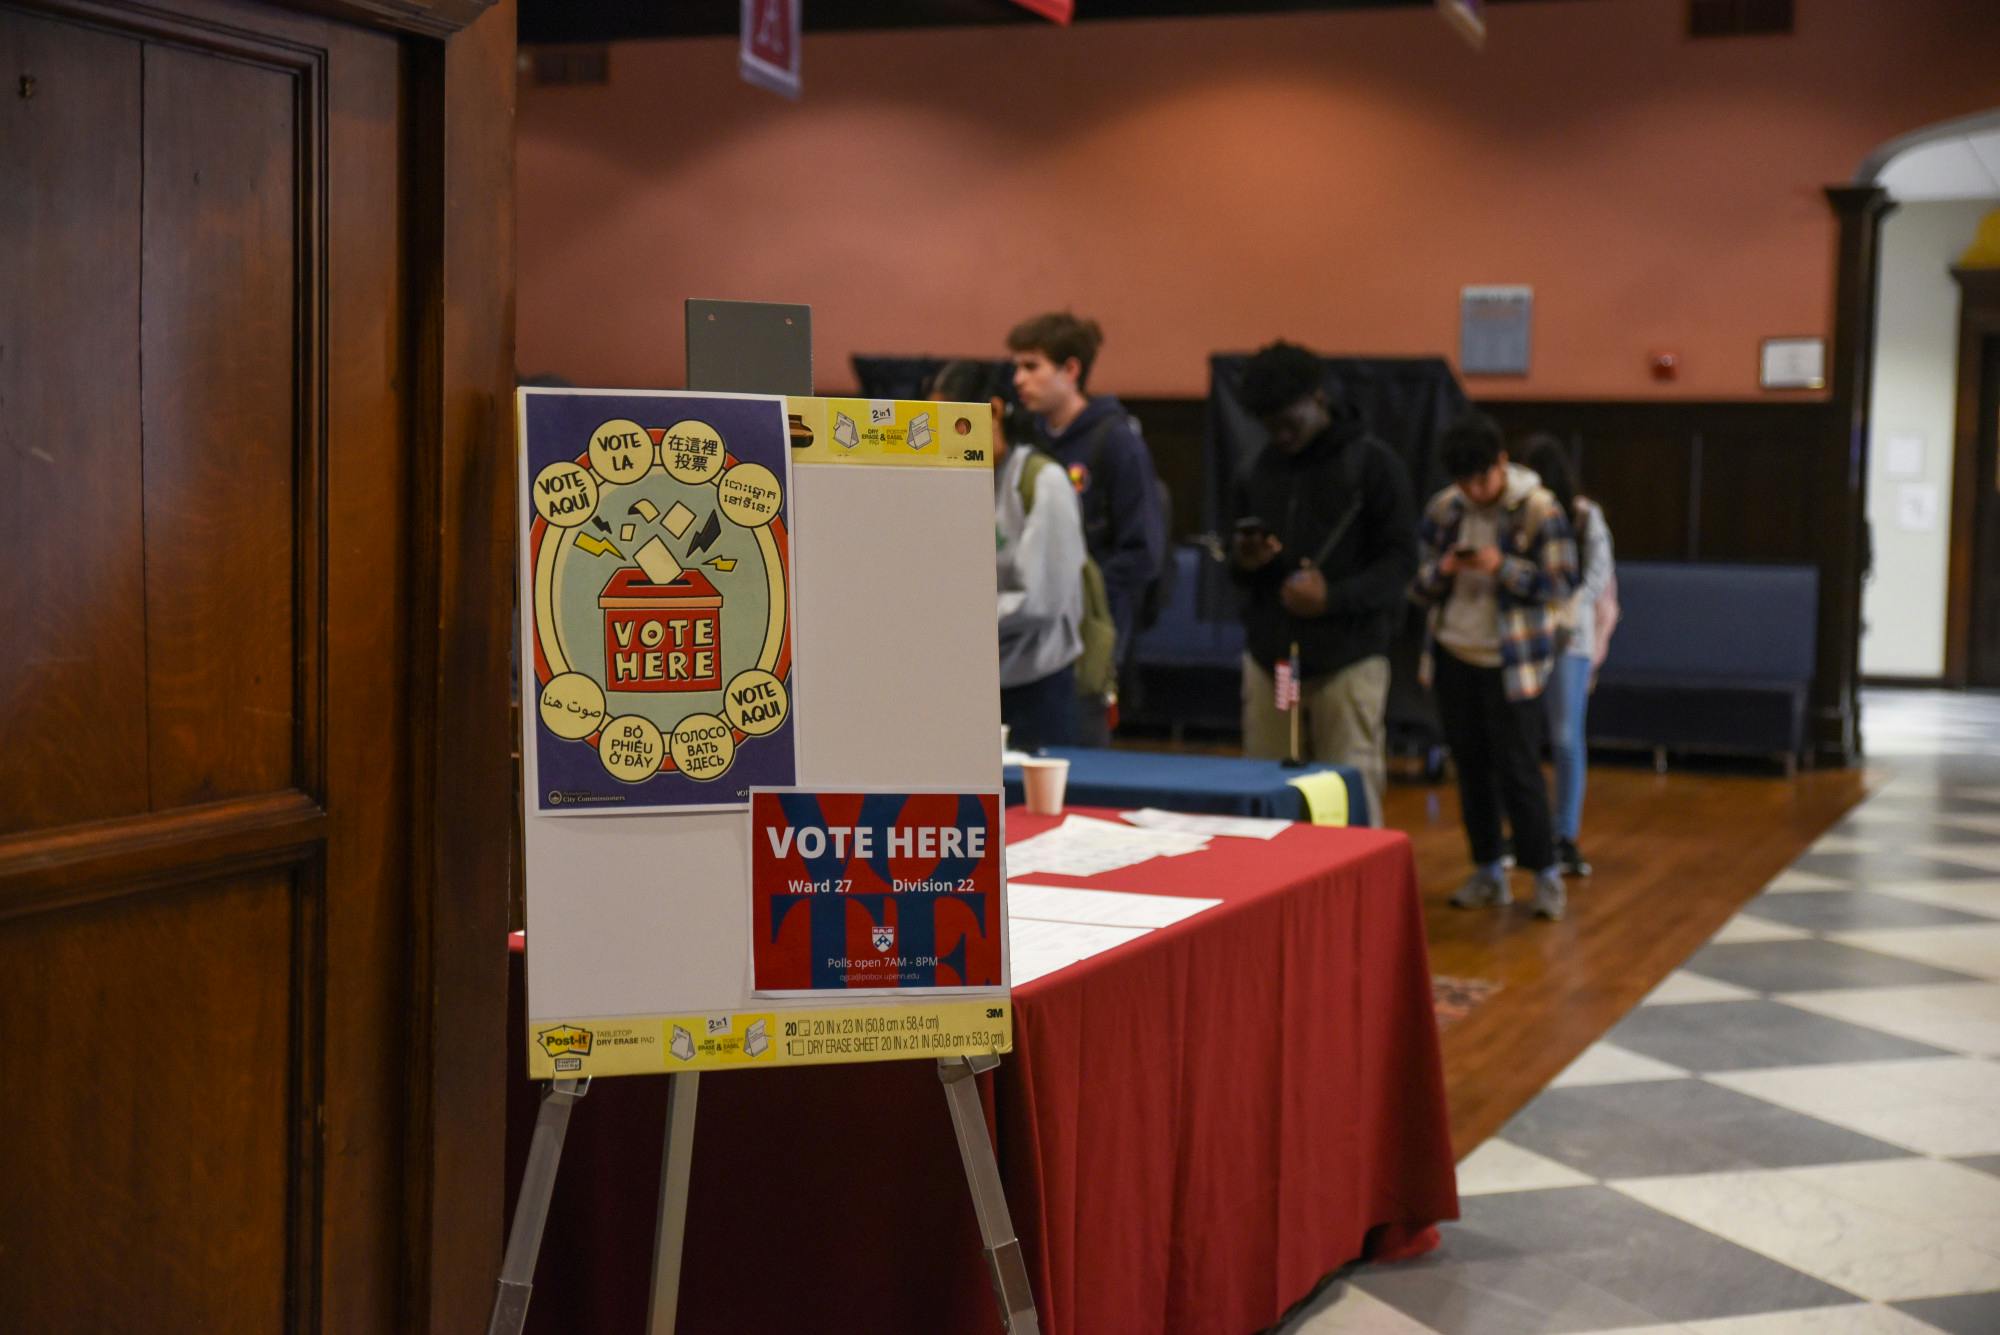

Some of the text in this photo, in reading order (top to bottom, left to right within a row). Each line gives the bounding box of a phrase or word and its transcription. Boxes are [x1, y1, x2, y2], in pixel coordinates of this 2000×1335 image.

[597, 432, 642, 452] VOTE
[668, 435, 718, 457] 在這裡
[612, 455, 634, 472] LA
[675, 454, 709, 473] 投票
[964, 450, 984, 461] 3M
[538, 470, 585, 495] VOTE
[549, 487, 590, 518] AQUÍ
[613, 619, 715, 648] VOTE
[615, 651, 715, 682] HERE
[731, 681, 777, 706] VOTE
[741, 705, 781, 727] AQUI
[674, 726, 726, 744] ГОЛОСО
[687, 741, 718, 757] ВАТЬ
[685, 755, 725, 771] ЗДЕСЬ
[767, 826, 986, 859] VOTE HERE
[788, 880, 852, 894] Ward 27
[893, 878, 975, 893] Division 22
[827, 958, 852, 969] Polls
[855, 959, 881, 970] open
[883, 957, 907, 967] 7AM
[915, 957, 938, 967] 8PM
[986, 1008, 1003, 1018] 3M
[596, 1029, 633, 1037] TABLETOP
[785, 1015, 939, 1036] 20 20 IN x 23 IN (50,8 cm x 58,4 cm)
[546, 1035, 587, 1046] Post-it
[614, 1037, 638, 1045] ERASE
[786, 1031, 1004, 1056] 1 DRY ERASE SHEET 20 IN x 21 IN (50,8 cm x 53,3 cm)
